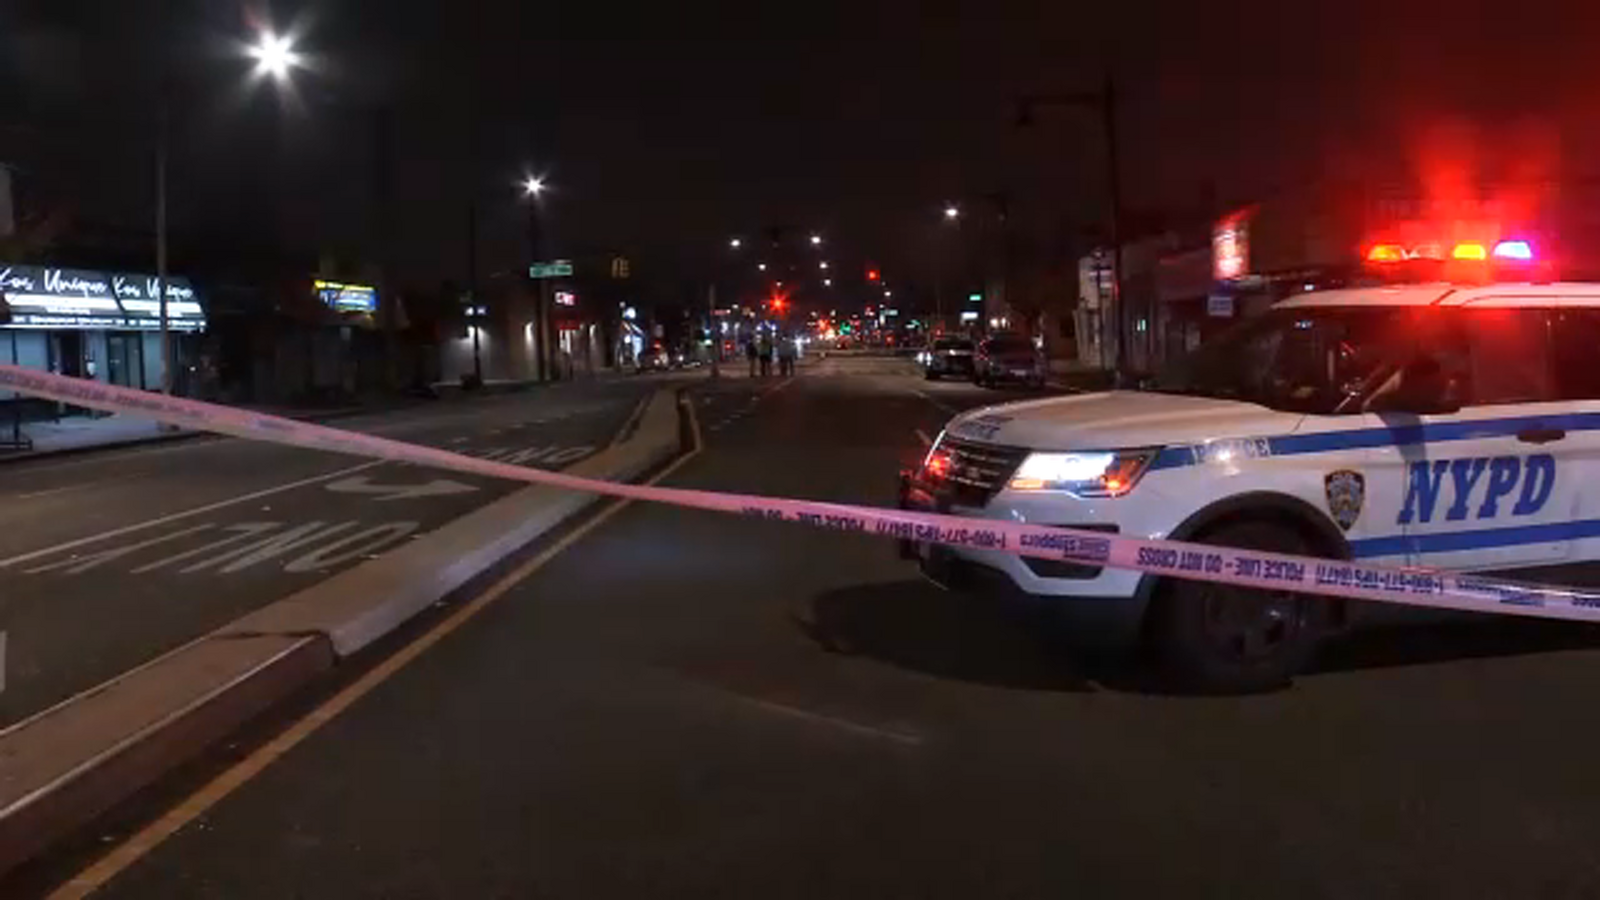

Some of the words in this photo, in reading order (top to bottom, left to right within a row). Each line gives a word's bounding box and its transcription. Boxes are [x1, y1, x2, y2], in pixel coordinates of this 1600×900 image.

[146, 277, 193, 302] Uique
[1193, 436, 1271, 463] POICE
[1396, 454, 1556, 525] NYPD
[1136, 546, 1177, 569] CROSS
[1179, 550, 1203, 571] NOT
[1205, 554, 1224, 574] DO
[1234, 556, 1262, 577] LINE
[1263, 559, 1305, 582] POLICE
